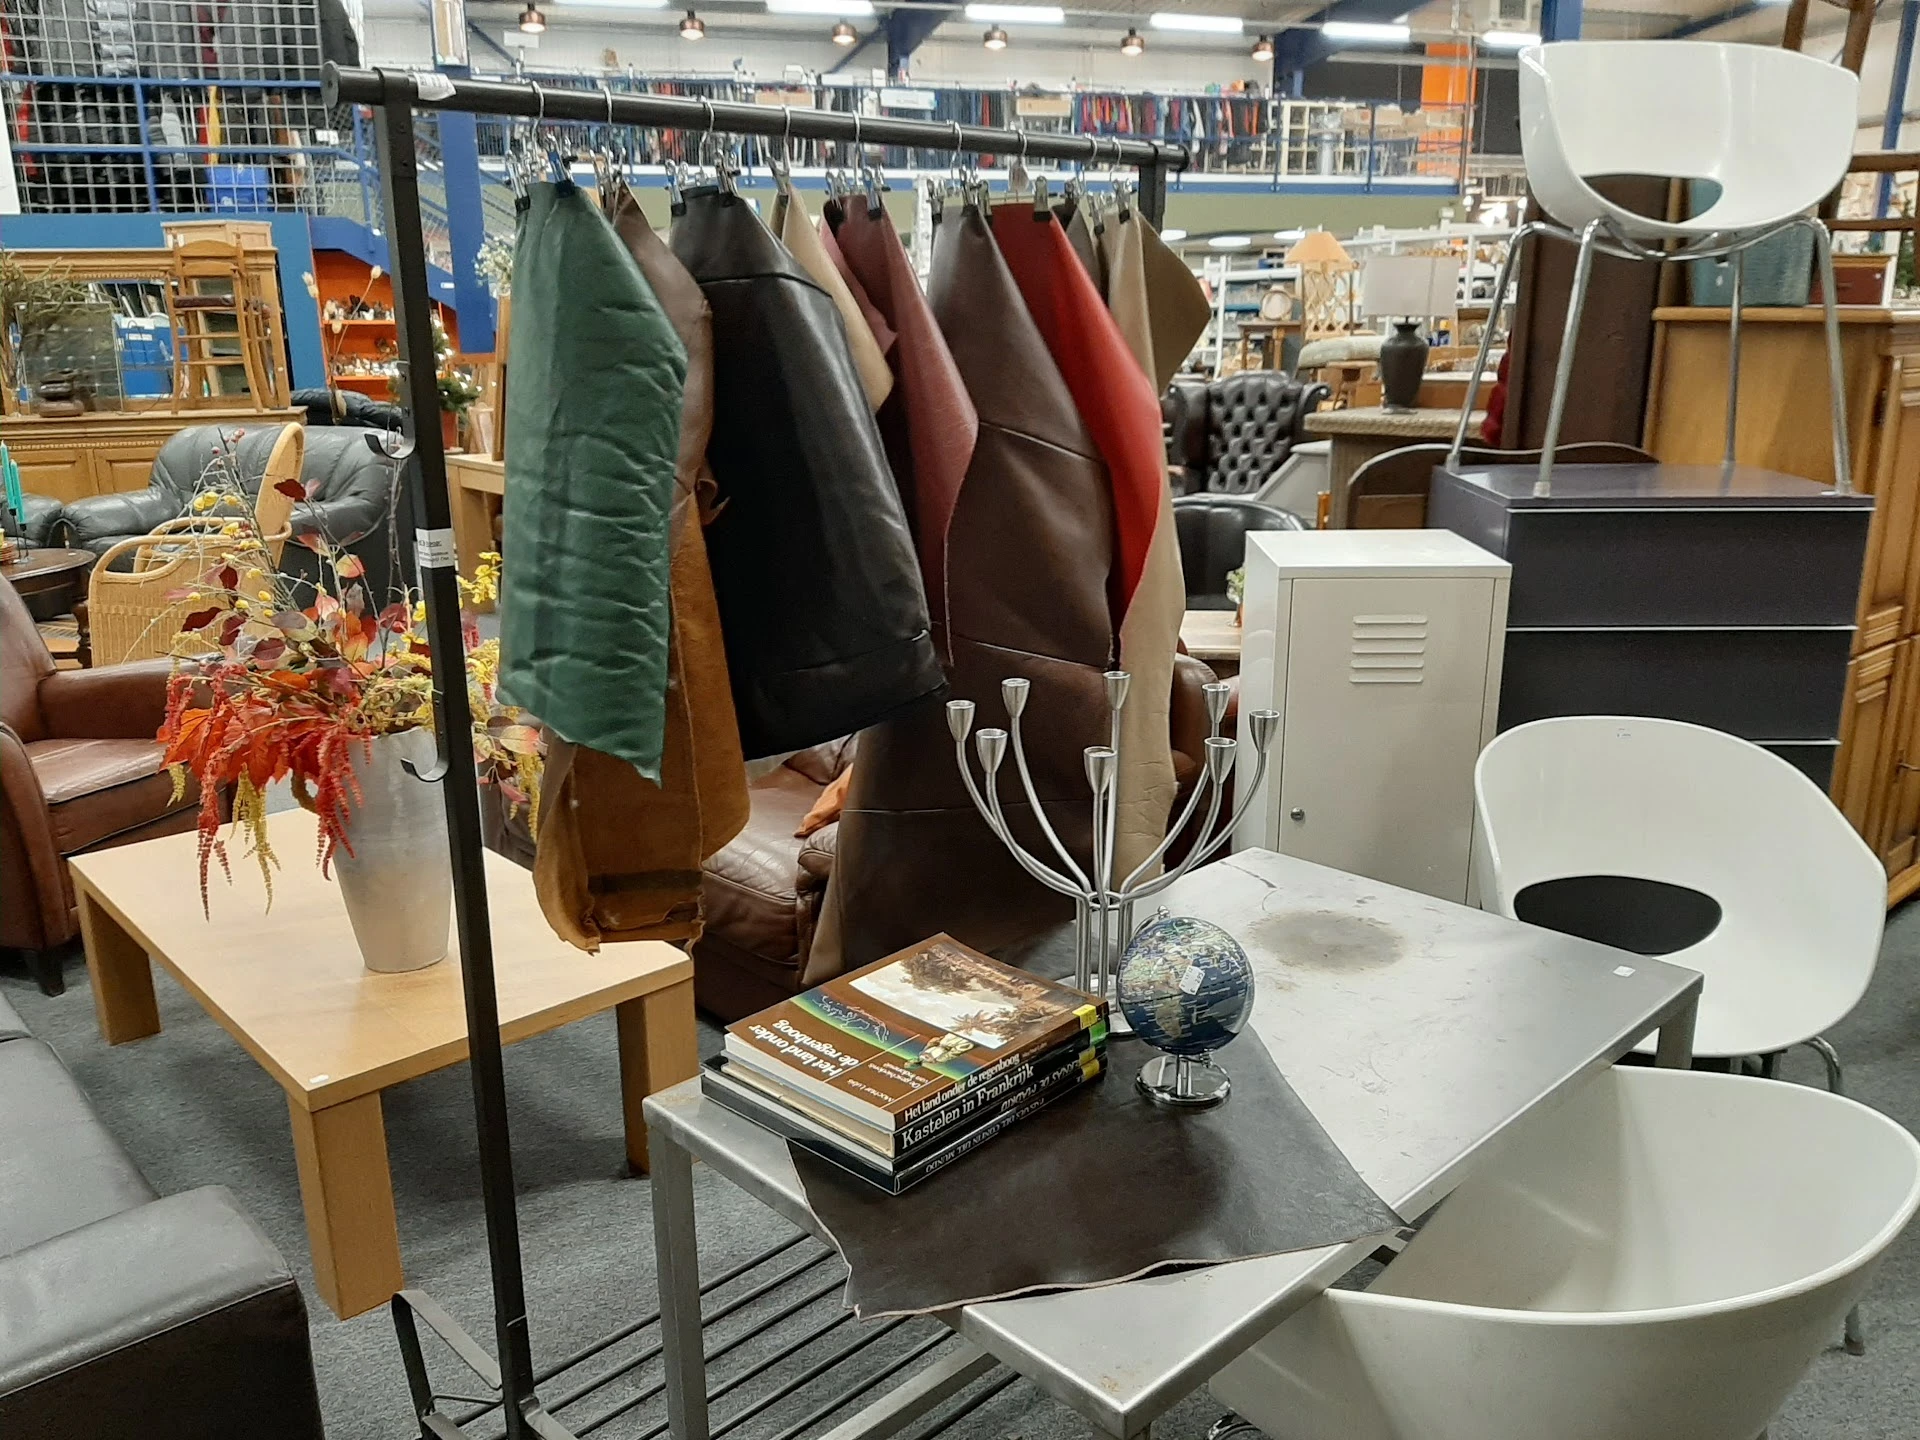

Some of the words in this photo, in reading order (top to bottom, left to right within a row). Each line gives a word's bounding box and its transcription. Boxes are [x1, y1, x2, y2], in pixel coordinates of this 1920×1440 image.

[748, 1024, 789, 1049] onder
[772, 1019, 842, 1059] regenboog
[780, 1043, 818, 1065] land
[838, 1055, 860, 1067] de
[811, 1060, 842, 1077] Het
[904, 1105, 921, 1122] Het
[922, 1091, 941, 1112] land
[941, 1081, 966, 1102] onder
[967, 1073, 978, 1088] de
[978, 1053, 1020, 1081] regenboog
[901, 1110, 960, 1150] Kastelen
[962, 1099, 975, 1116] in
[976, 1063, 1035, 1107] Frankrijk
[925, 1150, 956, 1173] MUNDO
